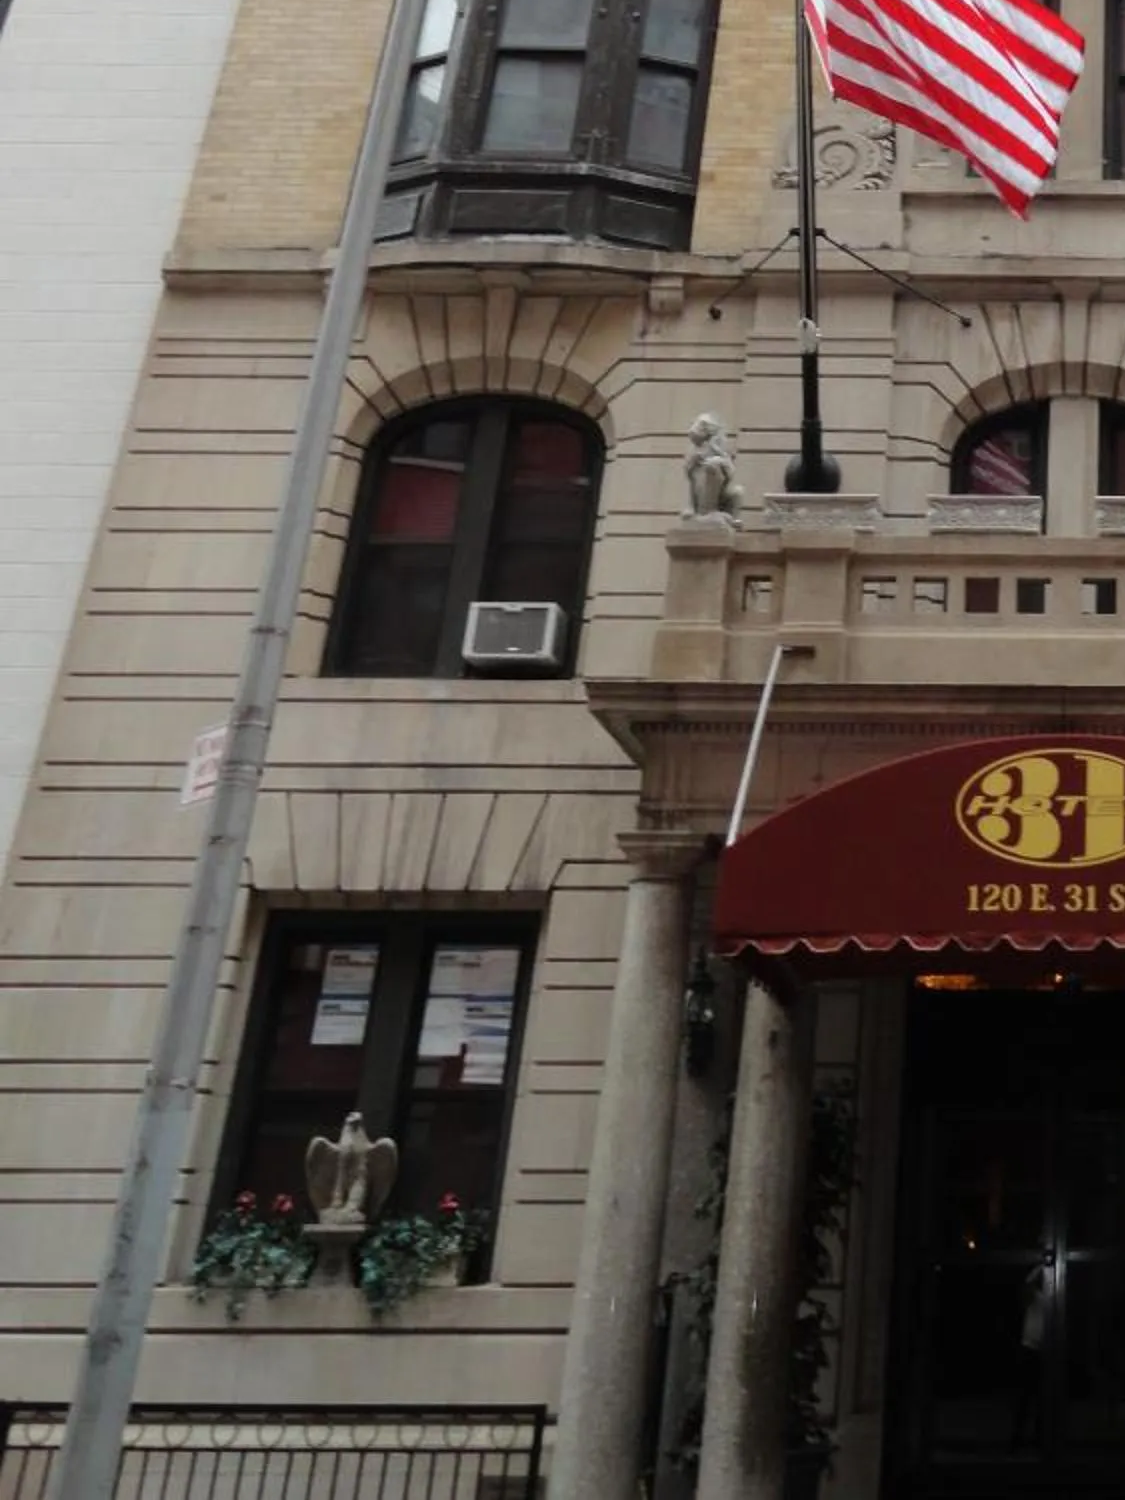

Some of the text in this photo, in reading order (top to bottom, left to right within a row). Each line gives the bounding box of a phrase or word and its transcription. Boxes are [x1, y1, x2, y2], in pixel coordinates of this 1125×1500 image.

[966, 884, 1022, 911] 120
[1030, 883, 1056, 911] E.
[1064, 884, 1098, 911] 31
